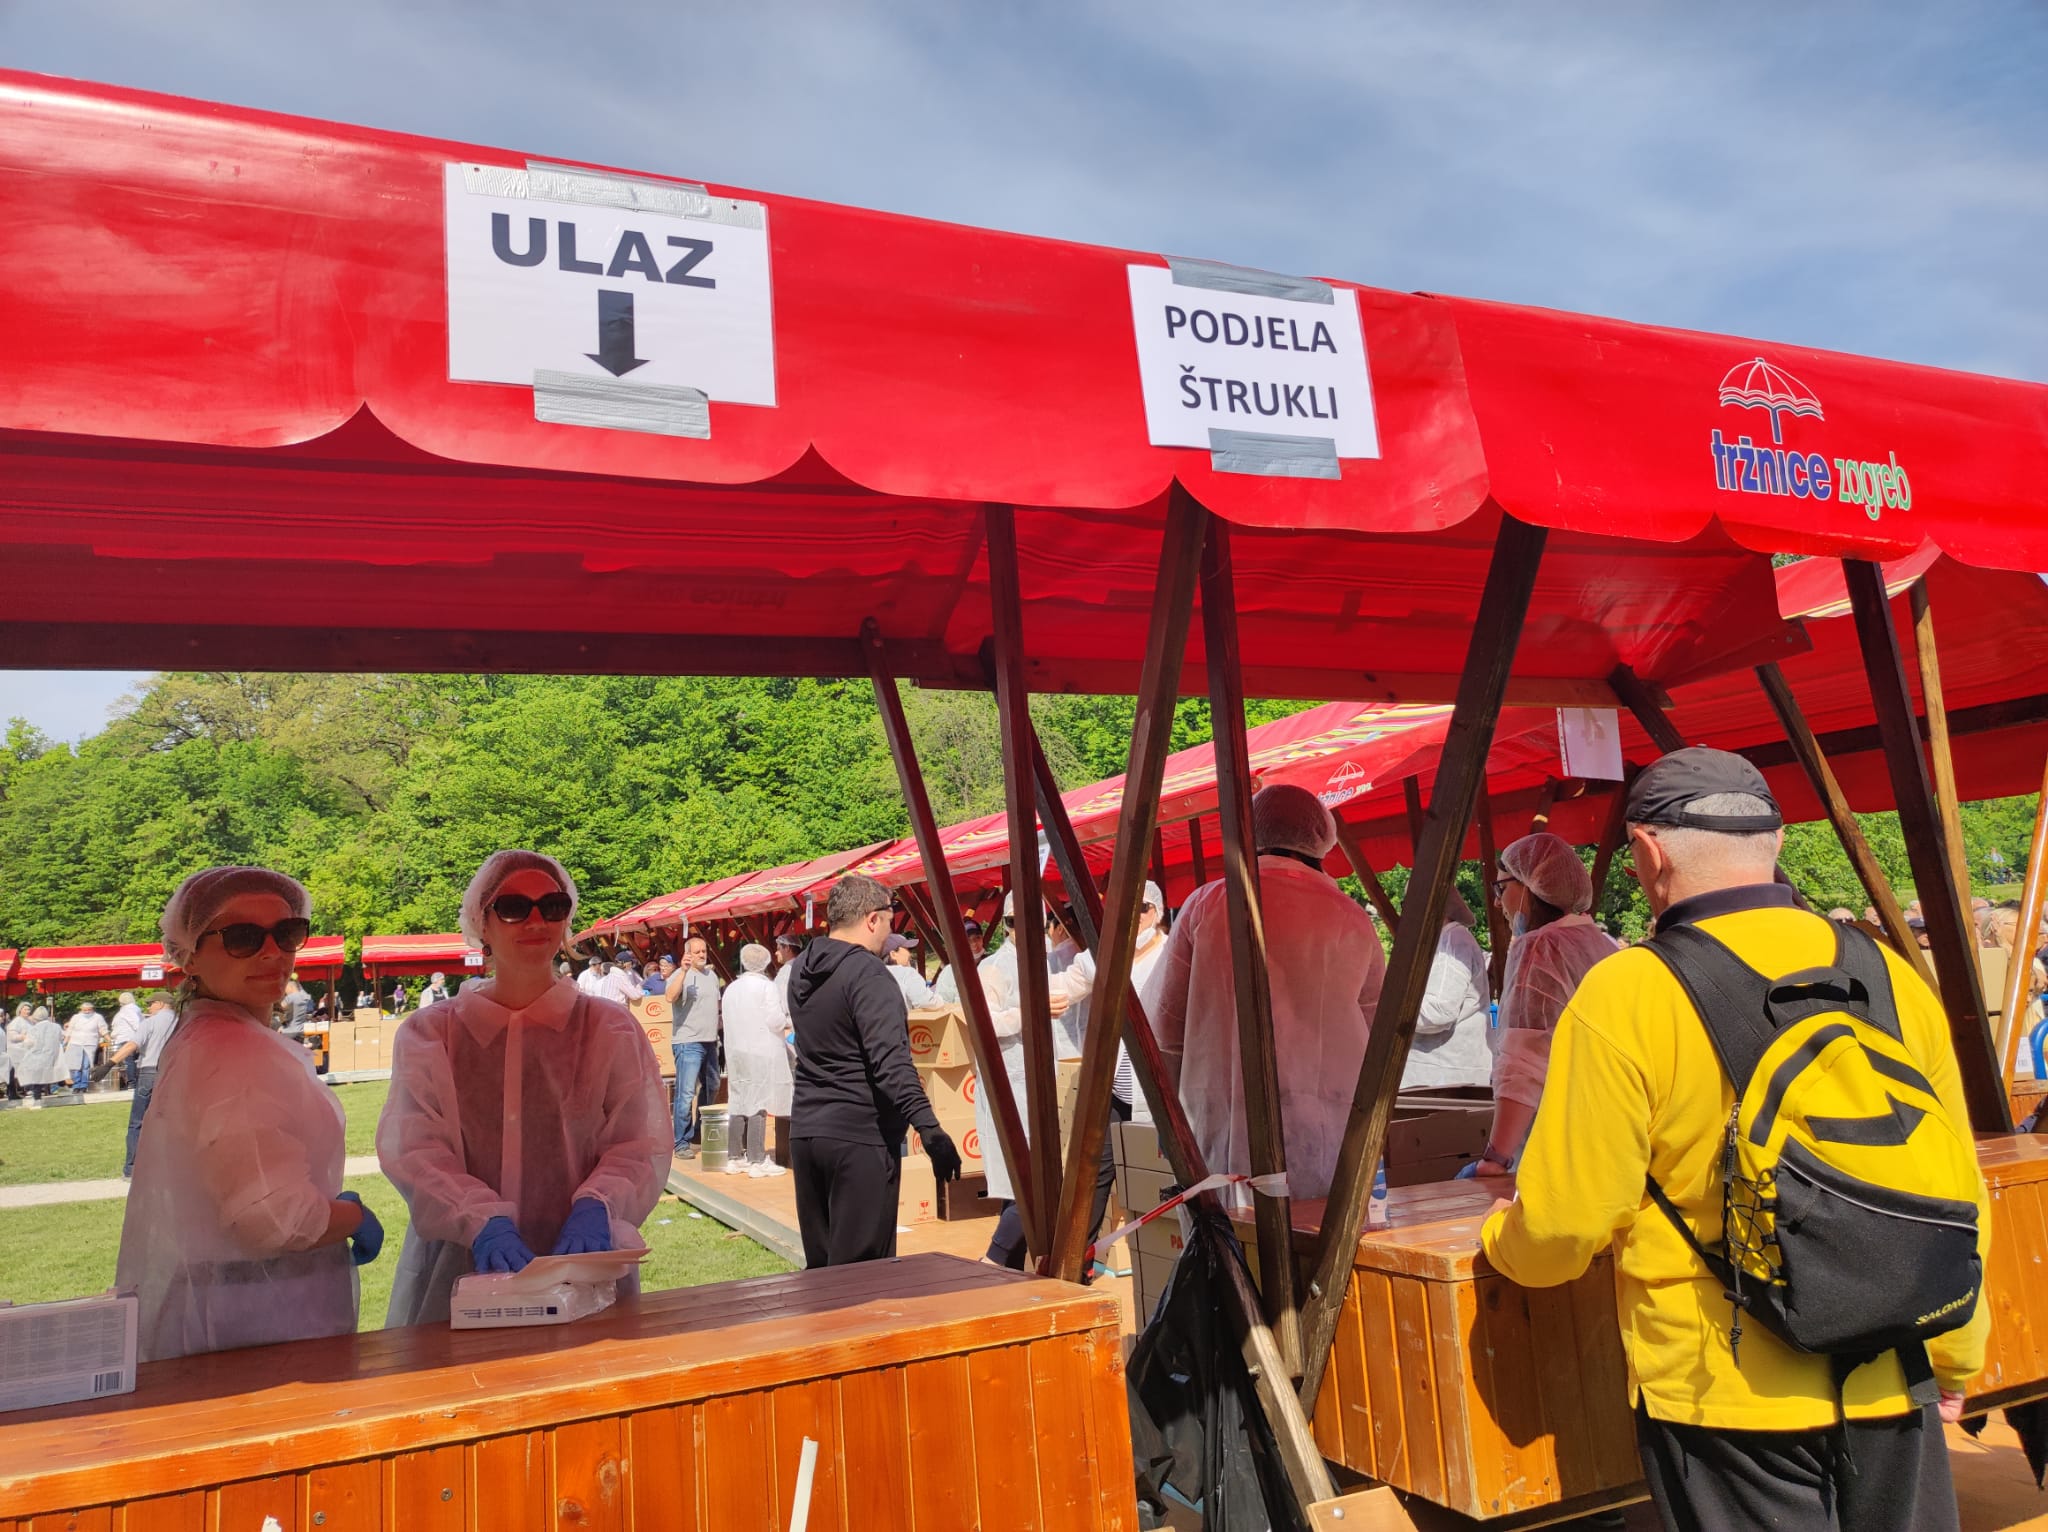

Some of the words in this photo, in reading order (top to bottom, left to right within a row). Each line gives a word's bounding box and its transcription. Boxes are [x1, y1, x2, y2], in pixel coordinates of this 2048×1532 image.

[491, 212, 716, 289] ULAZ
[1164, 304, 1338, 354] PODJELA
[1179, 364, 1338, 420] ŠTRUKLI
[1711, 428, 1832, 501] tržnice
[1833, 450, 1912, 521] zagreb
[1914, 1286, 1975, 1326] SALOMON
